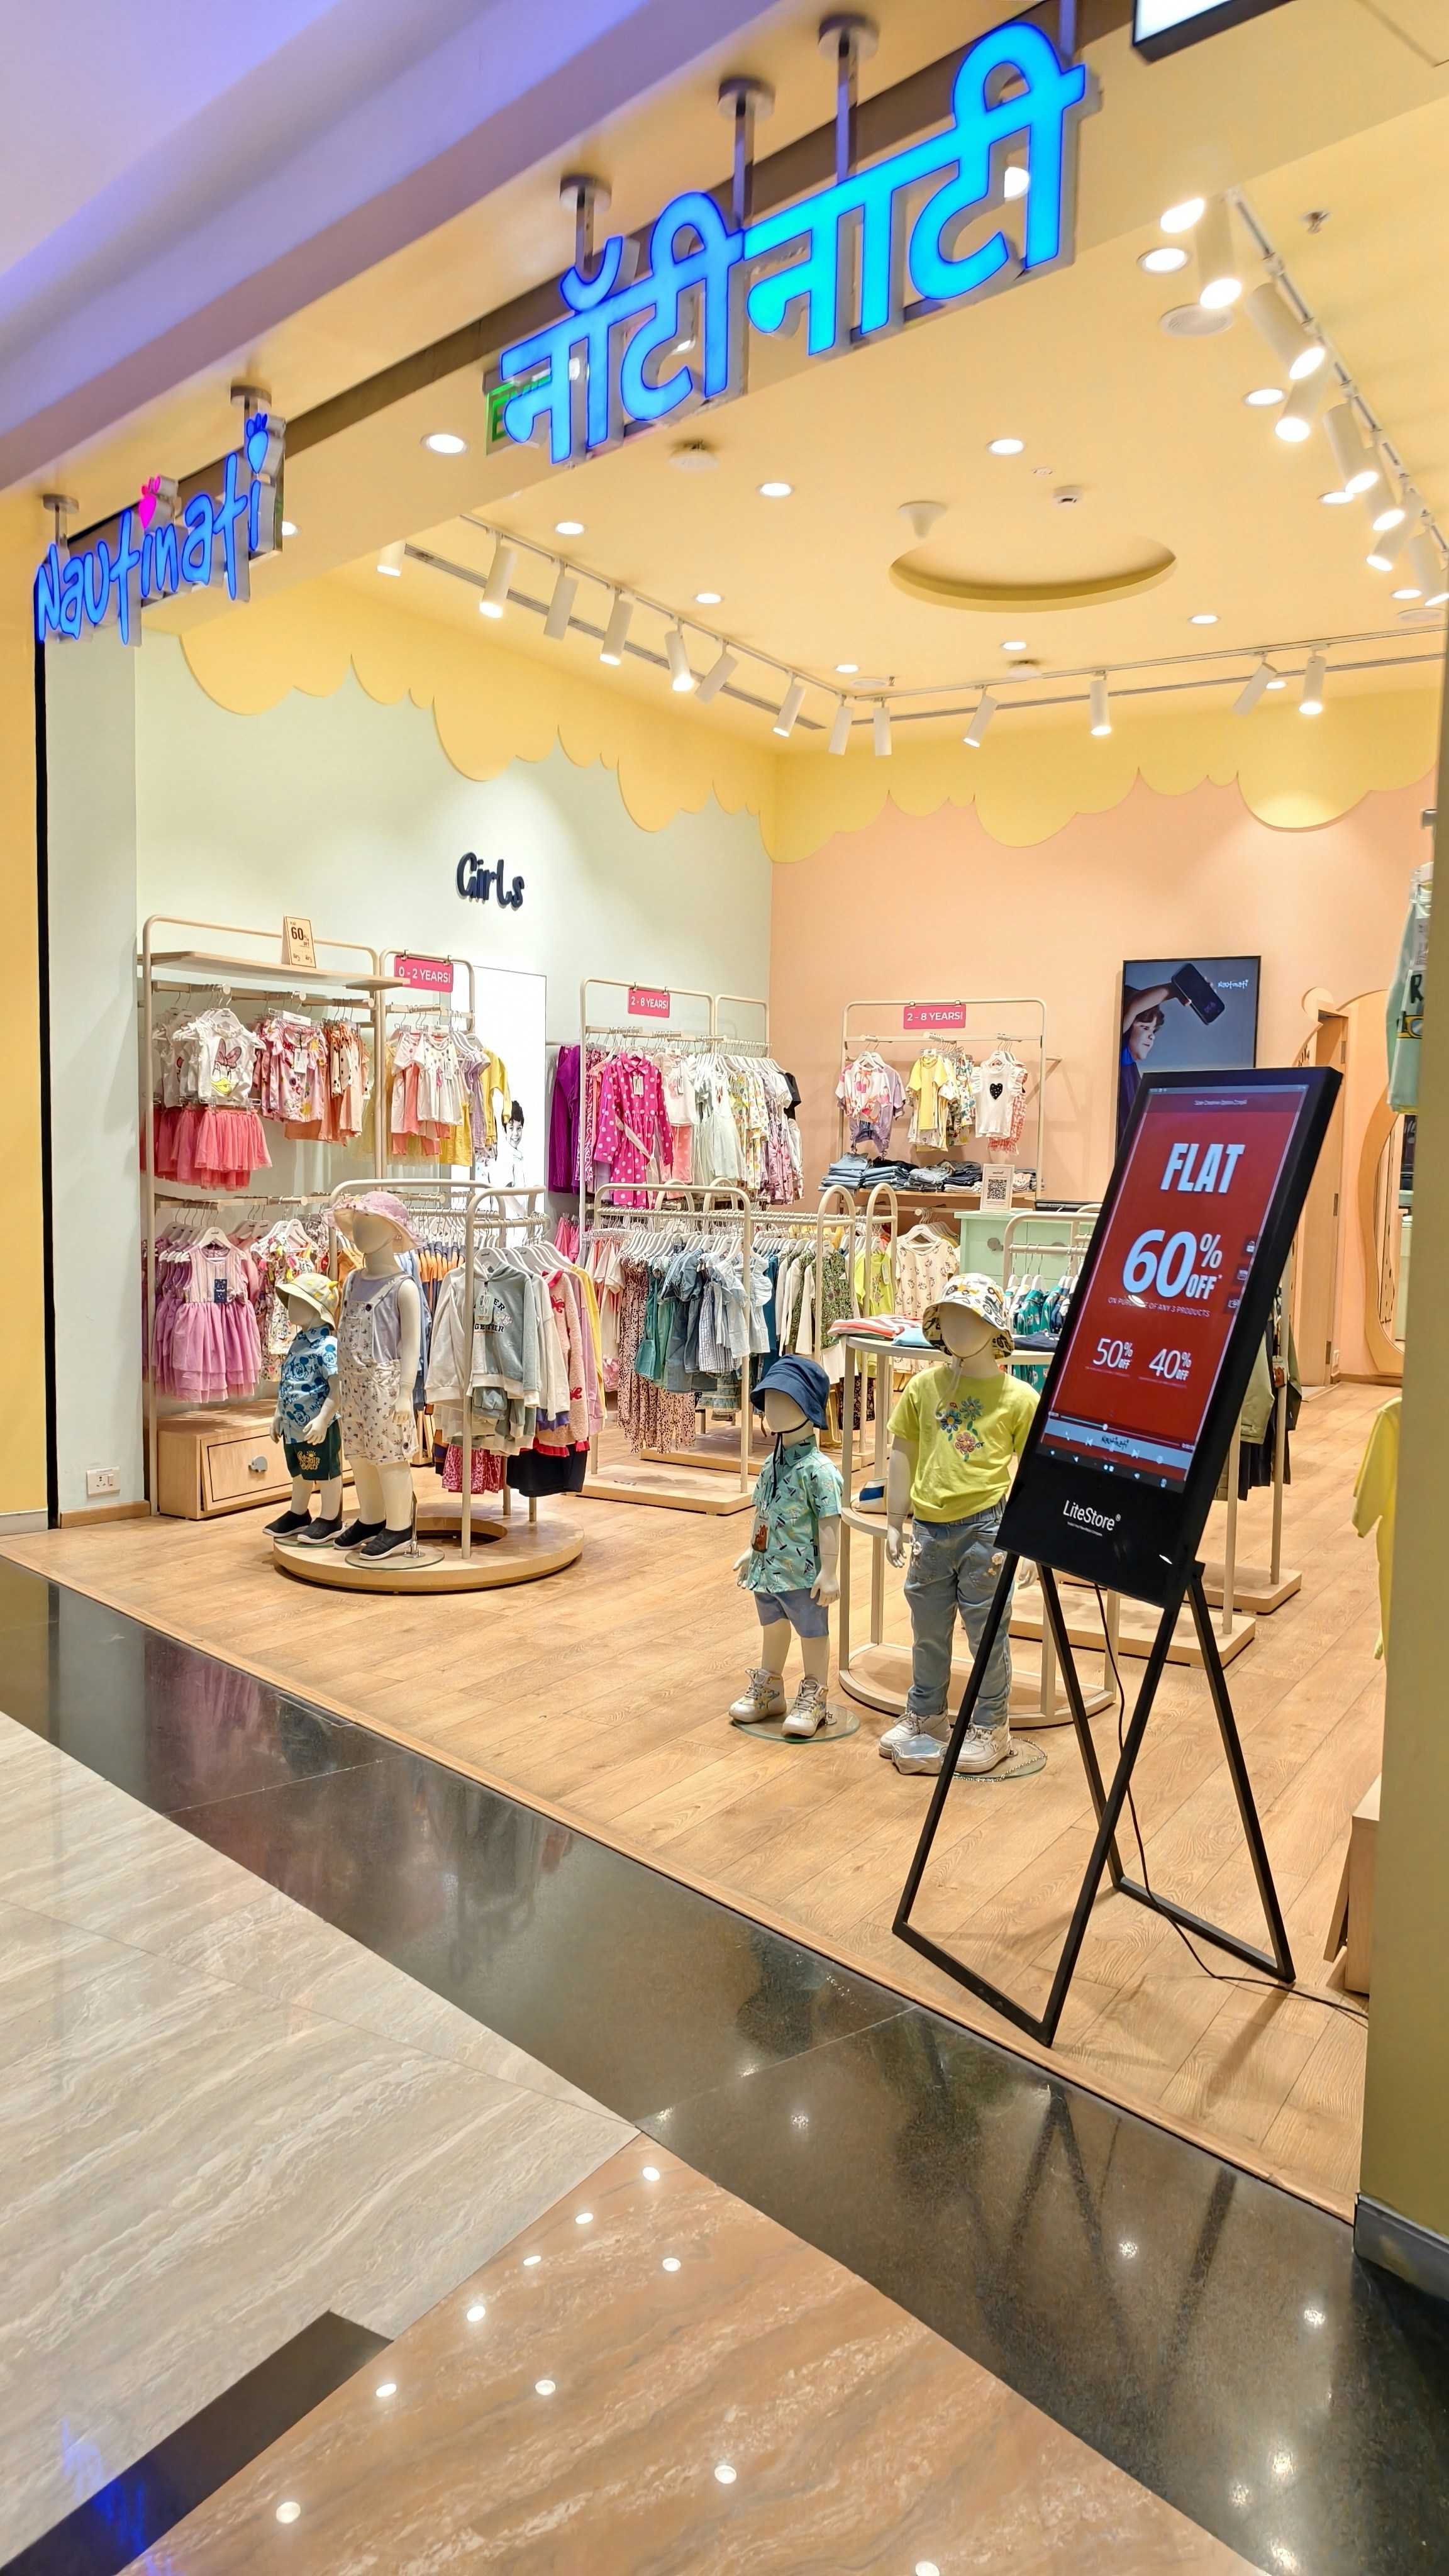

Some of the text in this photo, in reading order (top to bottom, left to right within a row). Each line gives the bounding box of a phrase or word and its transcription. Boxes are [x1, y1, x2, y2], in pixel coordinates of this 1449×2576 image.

[37, 413, 269, 646] Nautinati
[457, 852, 525, 908] Girls
[399, 966, 405, 977] 0
[412, 968, 418, 979] 2
[631, 996, 636, 1006] 2
[907, 1013, 913, 1021] 2
[921, 1013, 927, 1021] 8
[1160, 1143, 1246, 1193] FLAT
